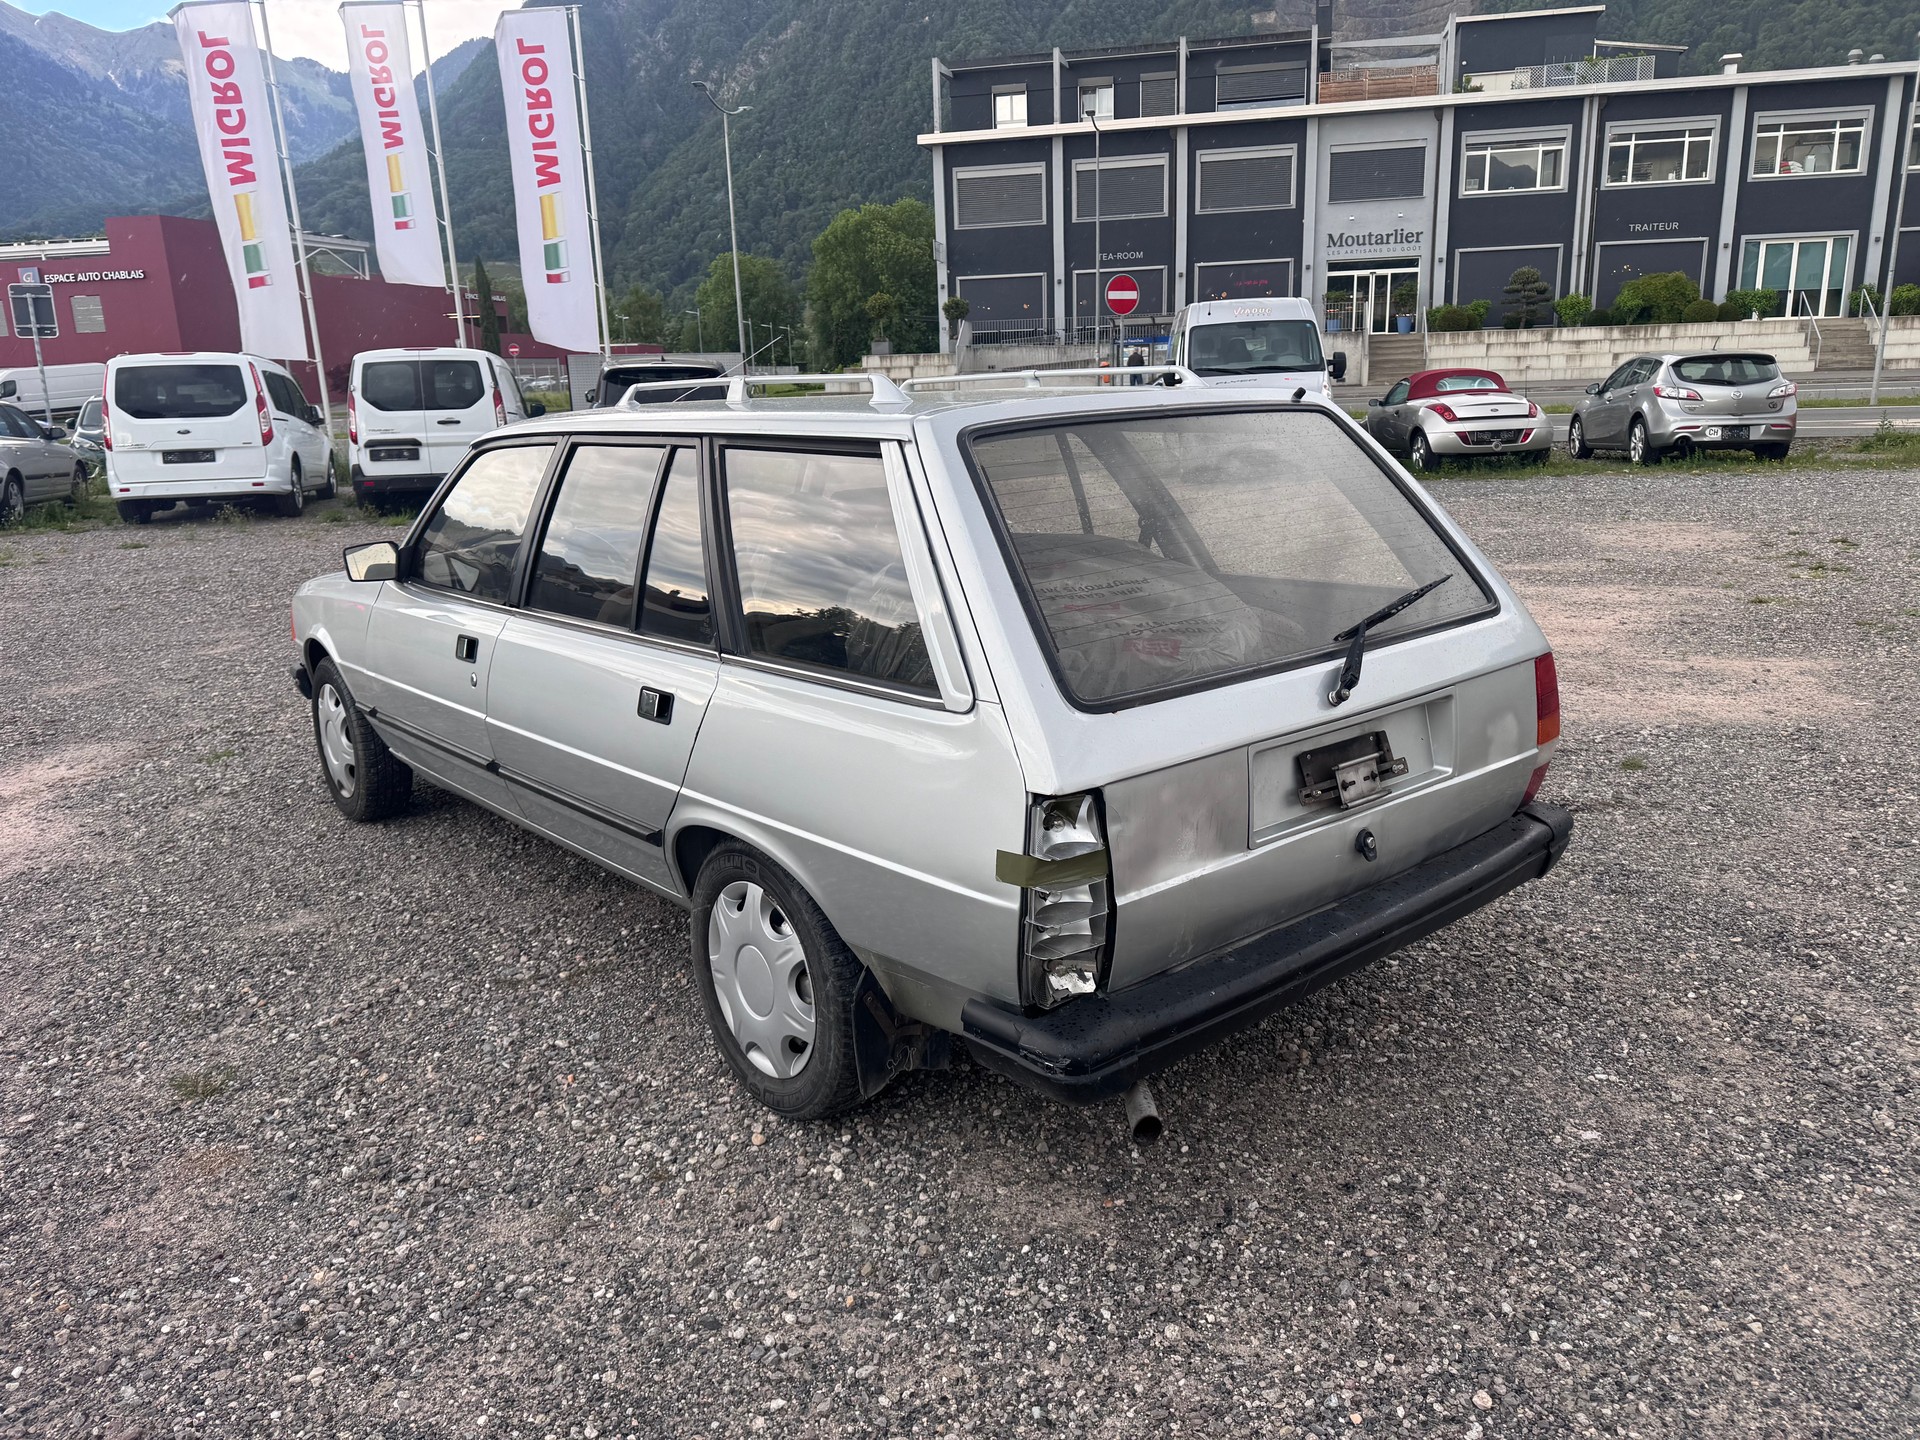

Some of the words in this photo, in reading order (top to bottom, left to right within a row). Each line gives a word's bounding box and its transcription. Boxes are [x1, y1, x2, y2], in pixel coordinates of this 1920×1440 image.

[1628, 221, 1679, 232] TRAITEUR
[1326, 228, 1424, 248] Moutarlier
[1344, 247, 1383, 255] ARTISANS
[1400, 244, 1422, 252] GOÛT
[1098, 251, 1144, 261] TEA-ROOM
[44, 273, 75, 284] ESPACE
[77, 271, 101, 282] AUTO
[102, 269, 144, 281] CHABLAIS
[1708, 428, 1719, 436] CH
